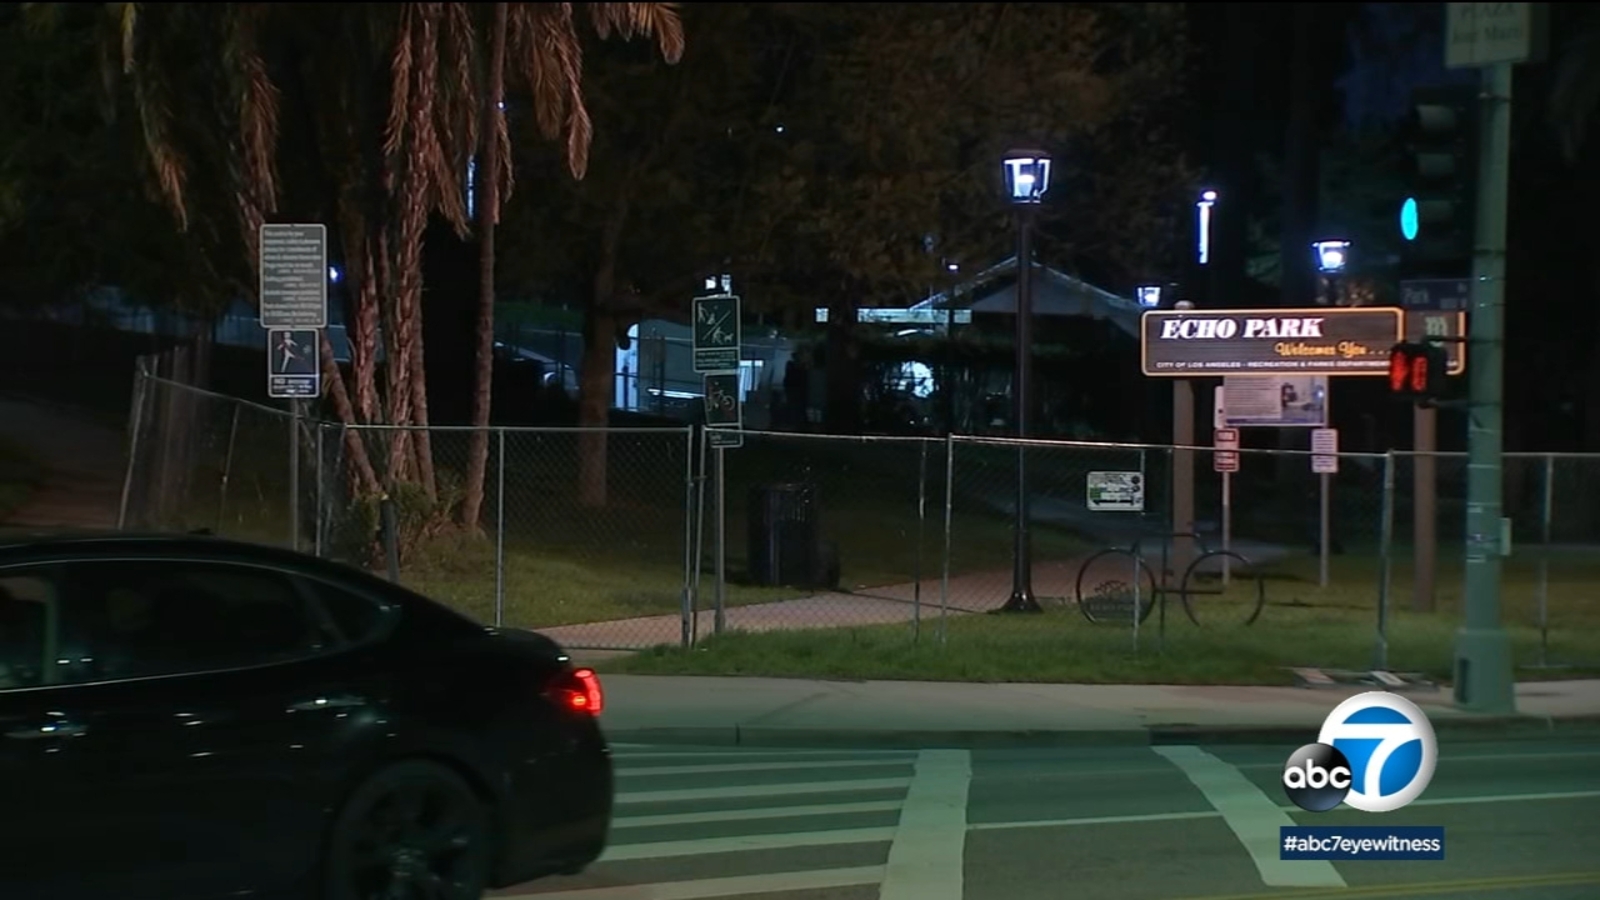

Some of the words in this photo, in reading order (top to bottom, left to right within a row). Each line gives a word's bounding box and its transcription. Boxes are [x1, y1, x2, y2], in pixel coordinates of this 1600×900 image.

[1161, 318, 1237, 339] ECHO
[1243, 317, 1324, 339] PARK
[1156, 361, 1174, 369] CITY
[1175, 361, 1186, 369] OF
[1187, 361, 1204, 369] LOS
[1307, 360, 1335, 368] PARKS
